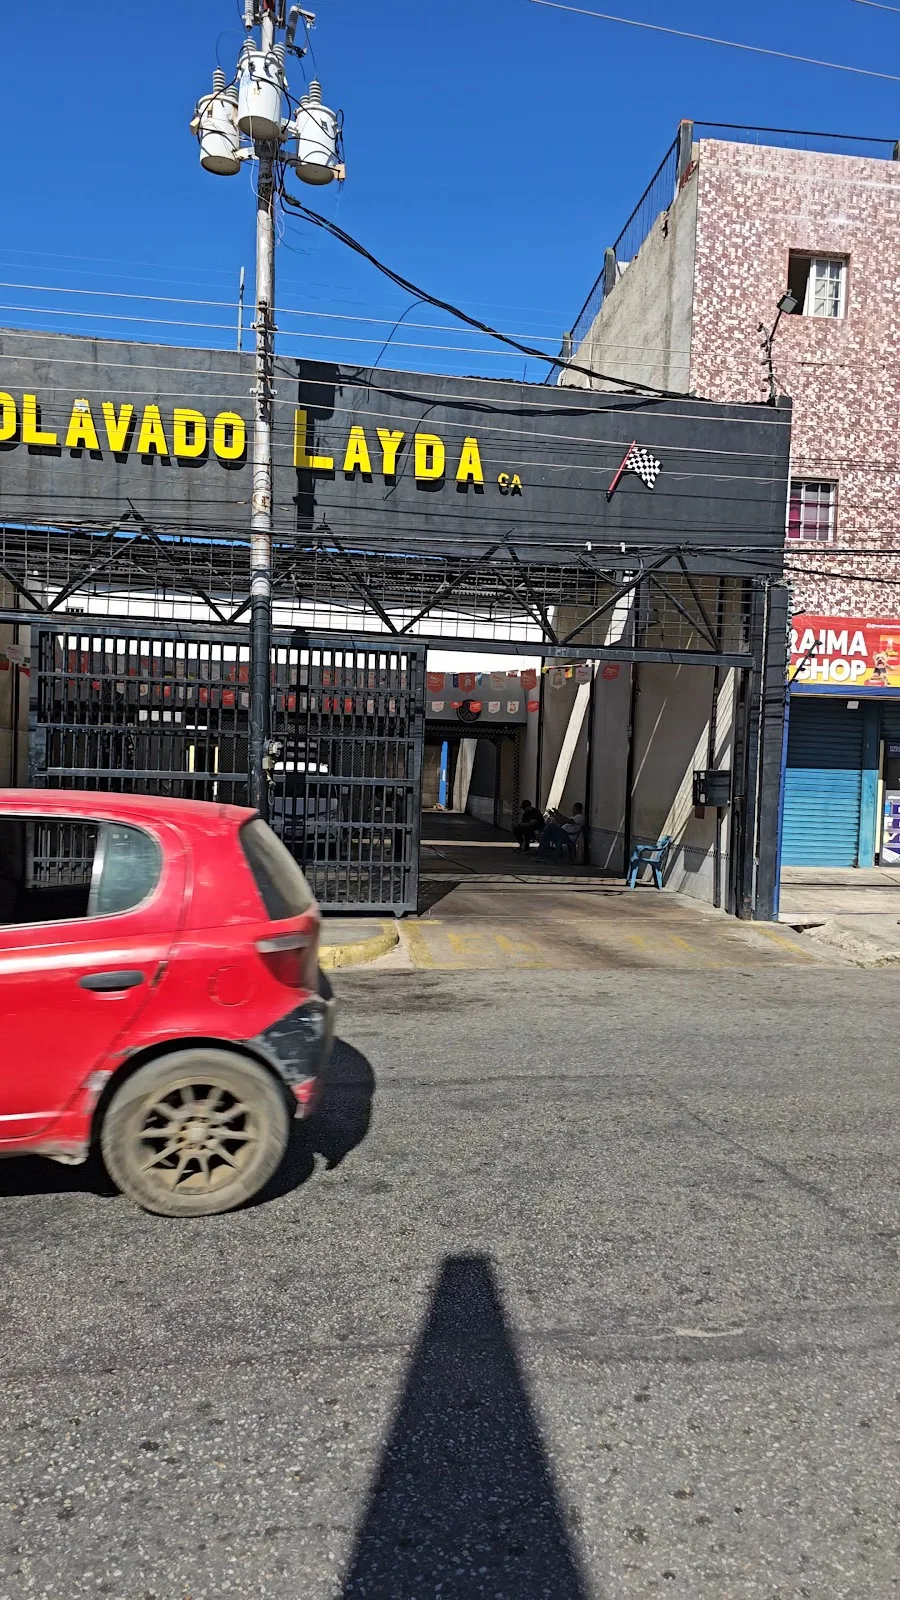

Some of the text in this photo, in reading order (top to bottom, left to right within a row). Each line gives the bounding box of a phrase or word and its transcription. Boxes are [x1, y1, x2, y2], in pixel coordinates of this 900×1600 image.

[293, 409, 485, 485] LAYDA
[497, 472, 522, 489] CA
[795, 657, 866, 682] SHOP
